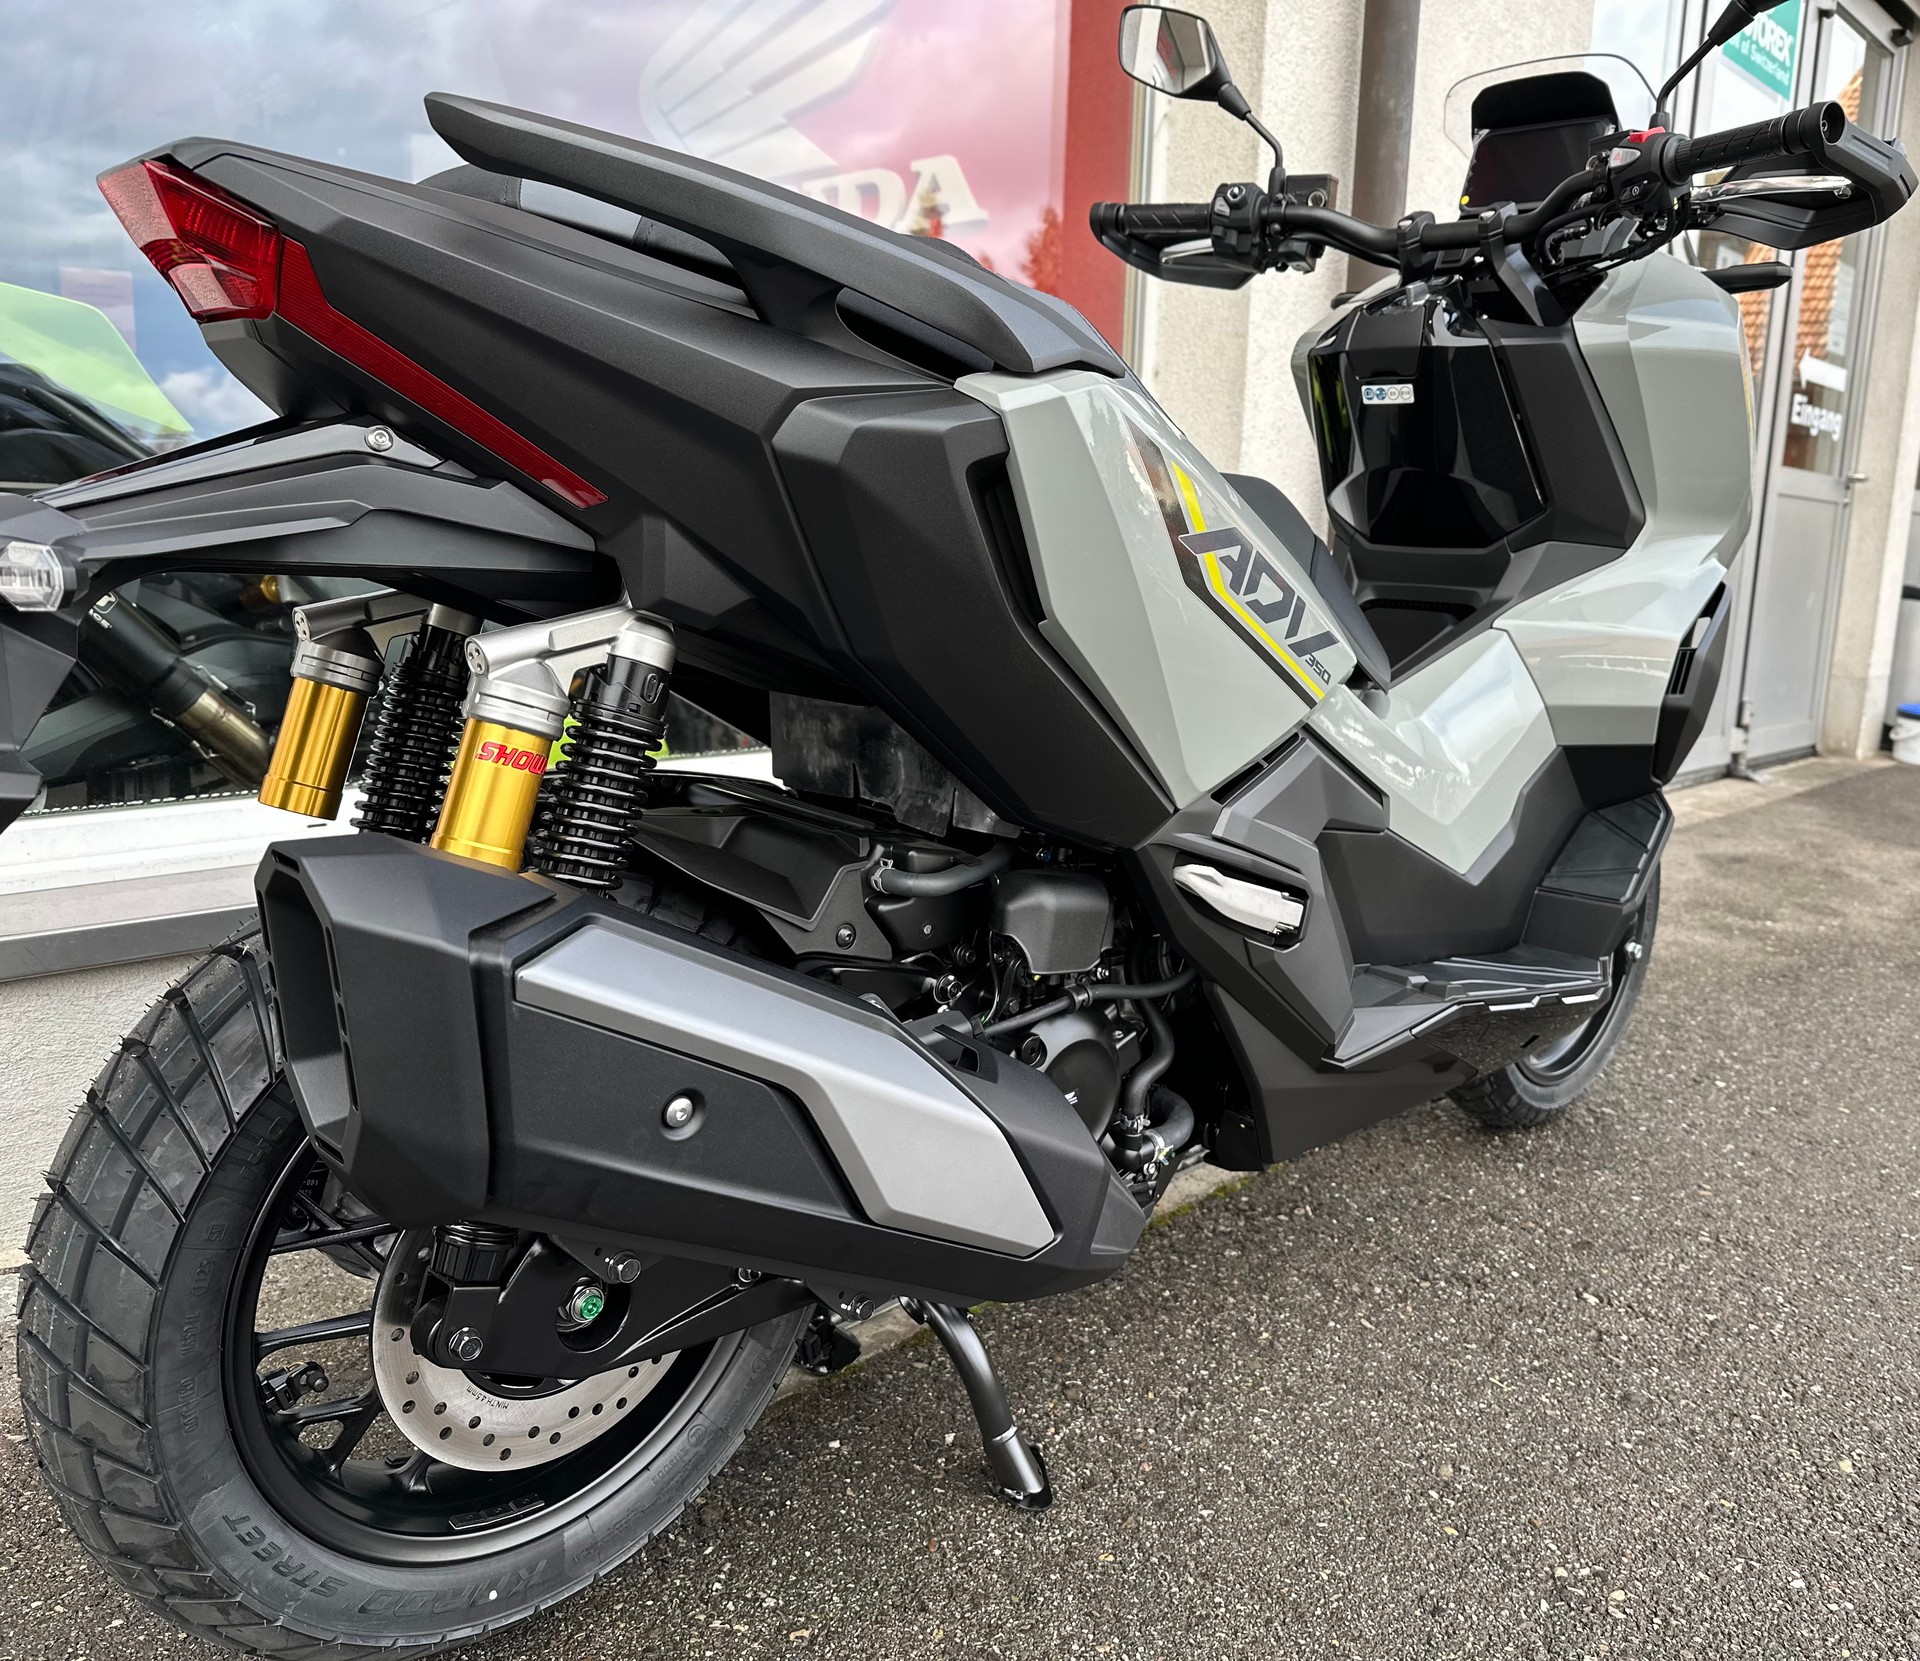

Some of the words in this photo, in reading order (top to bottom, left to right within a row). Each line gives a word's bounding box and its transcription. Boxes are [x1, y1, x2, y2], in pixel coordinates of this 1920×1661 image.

[1743, 11, 1794, 67] TOREX
[1750, 43, 1790, 86] Switzerland
[1791, 393, 1842, 442] Eingang
[1178, 526, 1340, 659] ADV
[1304, 653, 1332, 686] 350
[475, 741, 547, 776] SHOW
[222, 1514, 348, 1598] STREET
